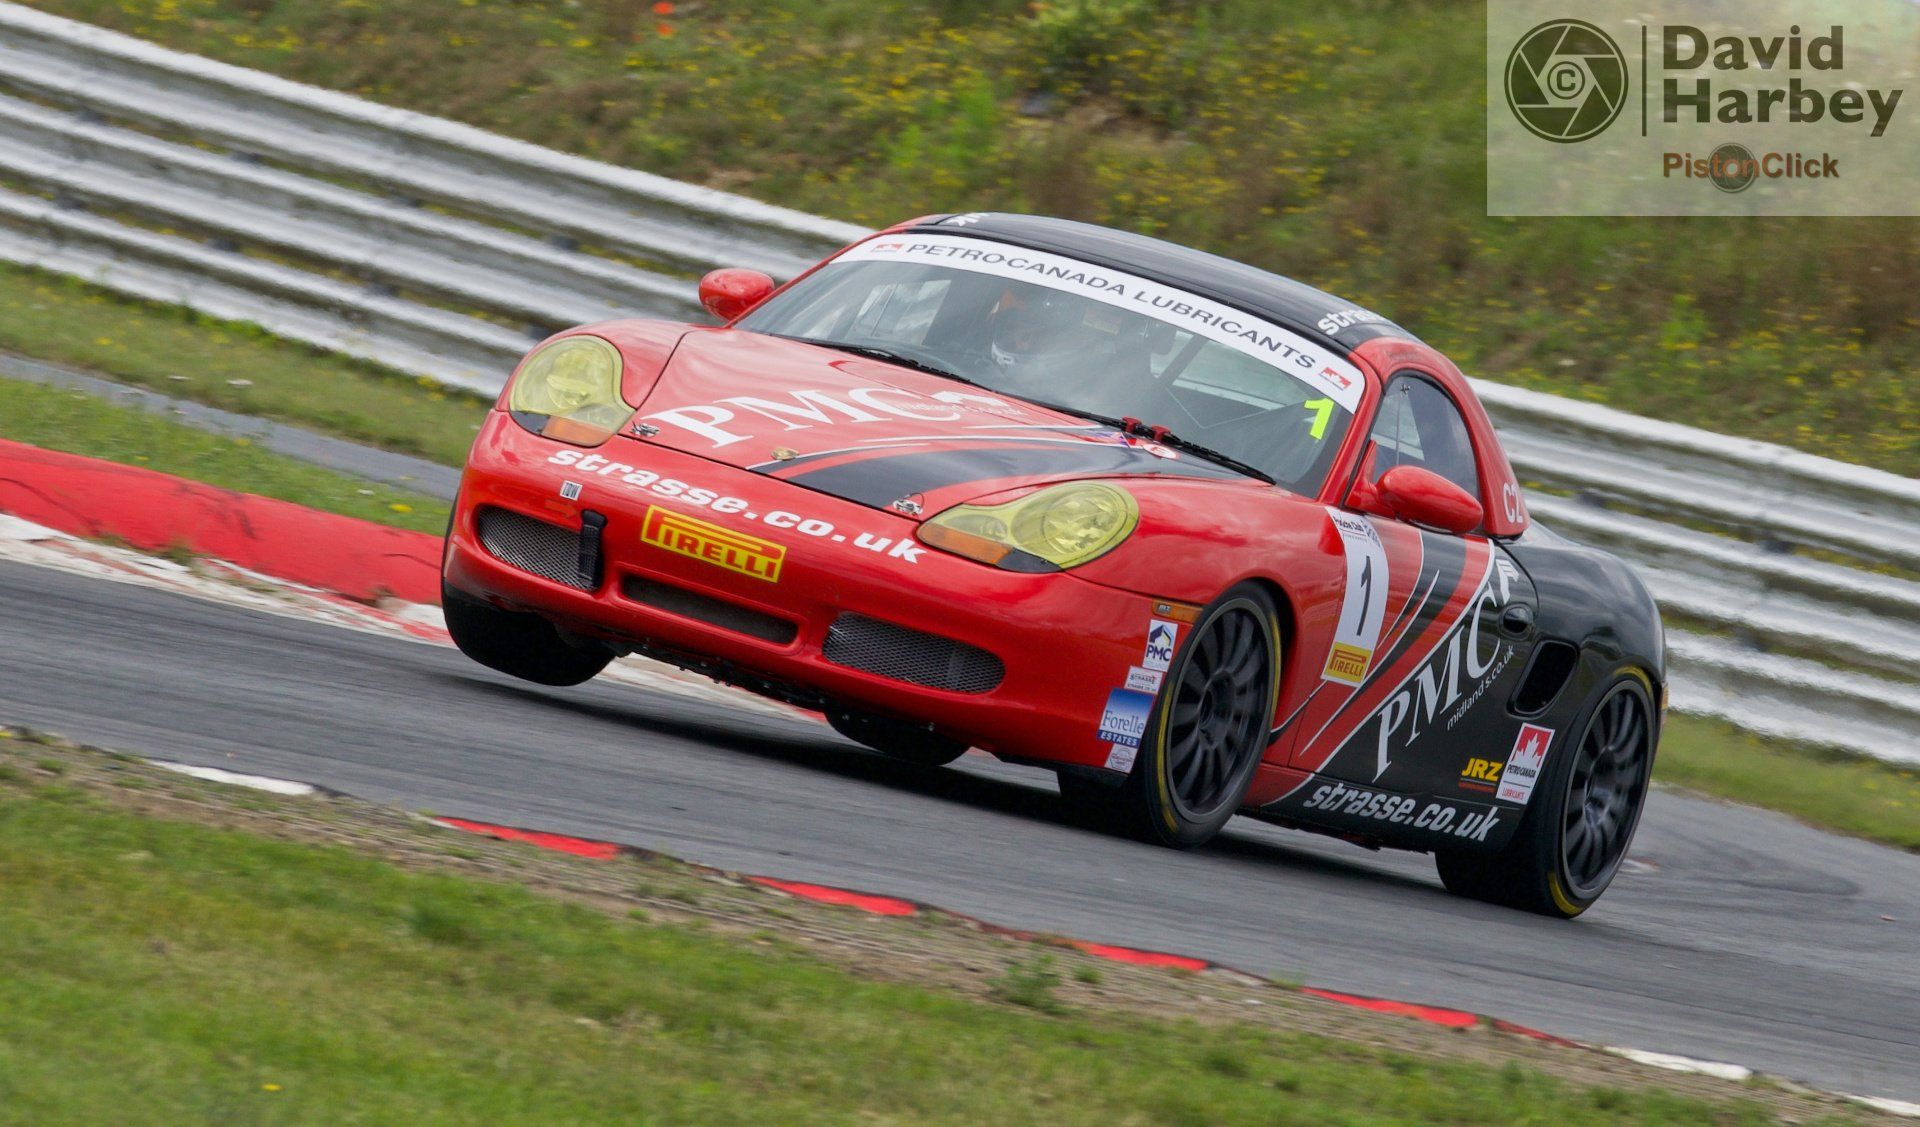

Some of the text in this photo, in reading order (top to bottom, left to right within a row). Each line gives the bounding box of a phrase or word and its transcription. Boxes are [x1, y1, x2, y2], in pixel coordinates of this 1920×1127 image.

[1132, 290, 1316, 371] LUBRICANTS
[639, 387, 961, 449] PMC
[1303, 398, 1335, 441] 1
[547, 448, 927, 565] strasse.co.uk
[1502, 482, 1524, 525] C2
[644, 512, 784, 580] PIRELLI
[1360, 555, 1372, 637] 1
[1146, 644, 1172, 662] PMC
[1328, 649, 1367, 678] PIRELLI
[1372, 580, 1499, 784] PMC
[1101, 732, 1138, 746] ESTATES
[1102, 710, 1145, 734] Forelle
[1461, 757, 1503, 782] JRZ
[1303, 783, 1500, 842] strasse.co.uk
